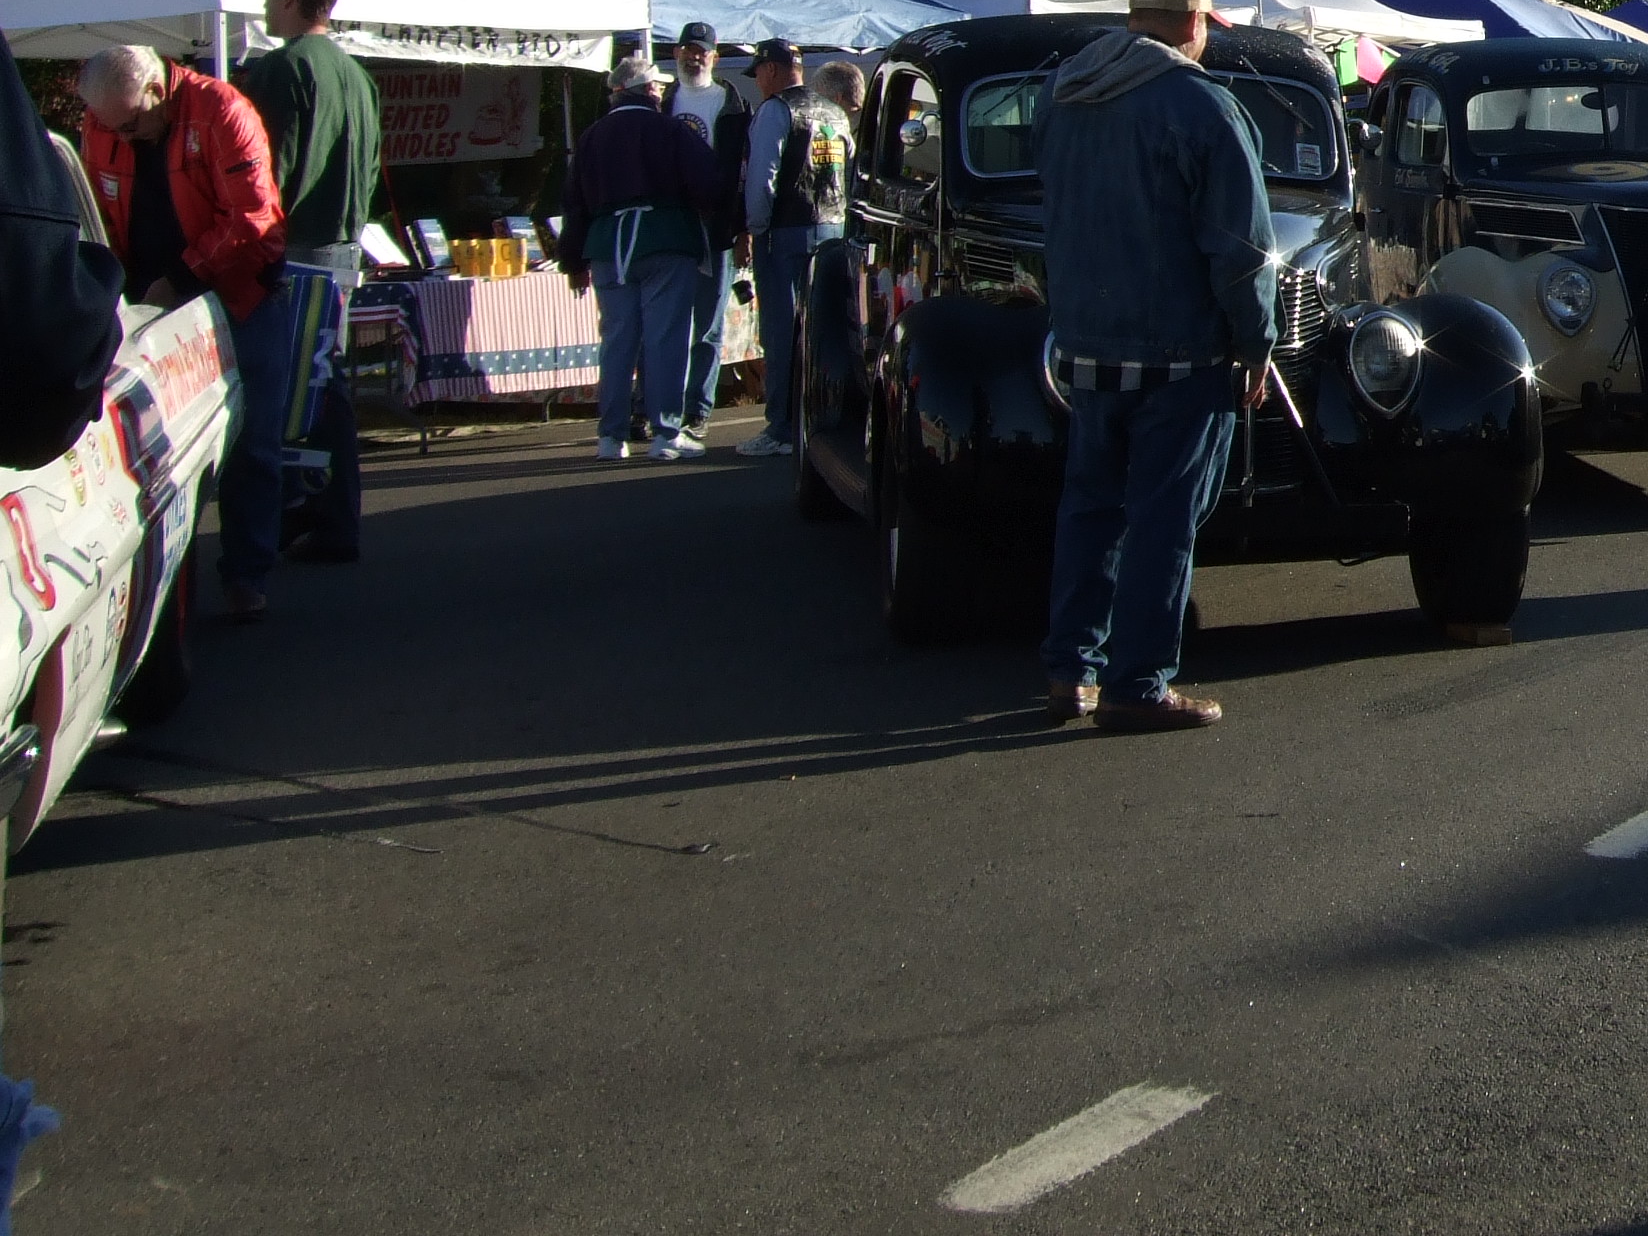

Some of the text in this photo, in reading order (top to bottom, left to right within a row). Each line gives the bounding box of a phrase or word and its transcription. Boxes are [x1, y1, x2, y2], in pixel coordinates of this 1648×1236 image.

[1603, 58, 1639, 75] Toy
[377, 74, 462, 100] OUNTAIN
[382, 104, 450, 132] ENTED
[381, 132, 462, 161] ANDLES
